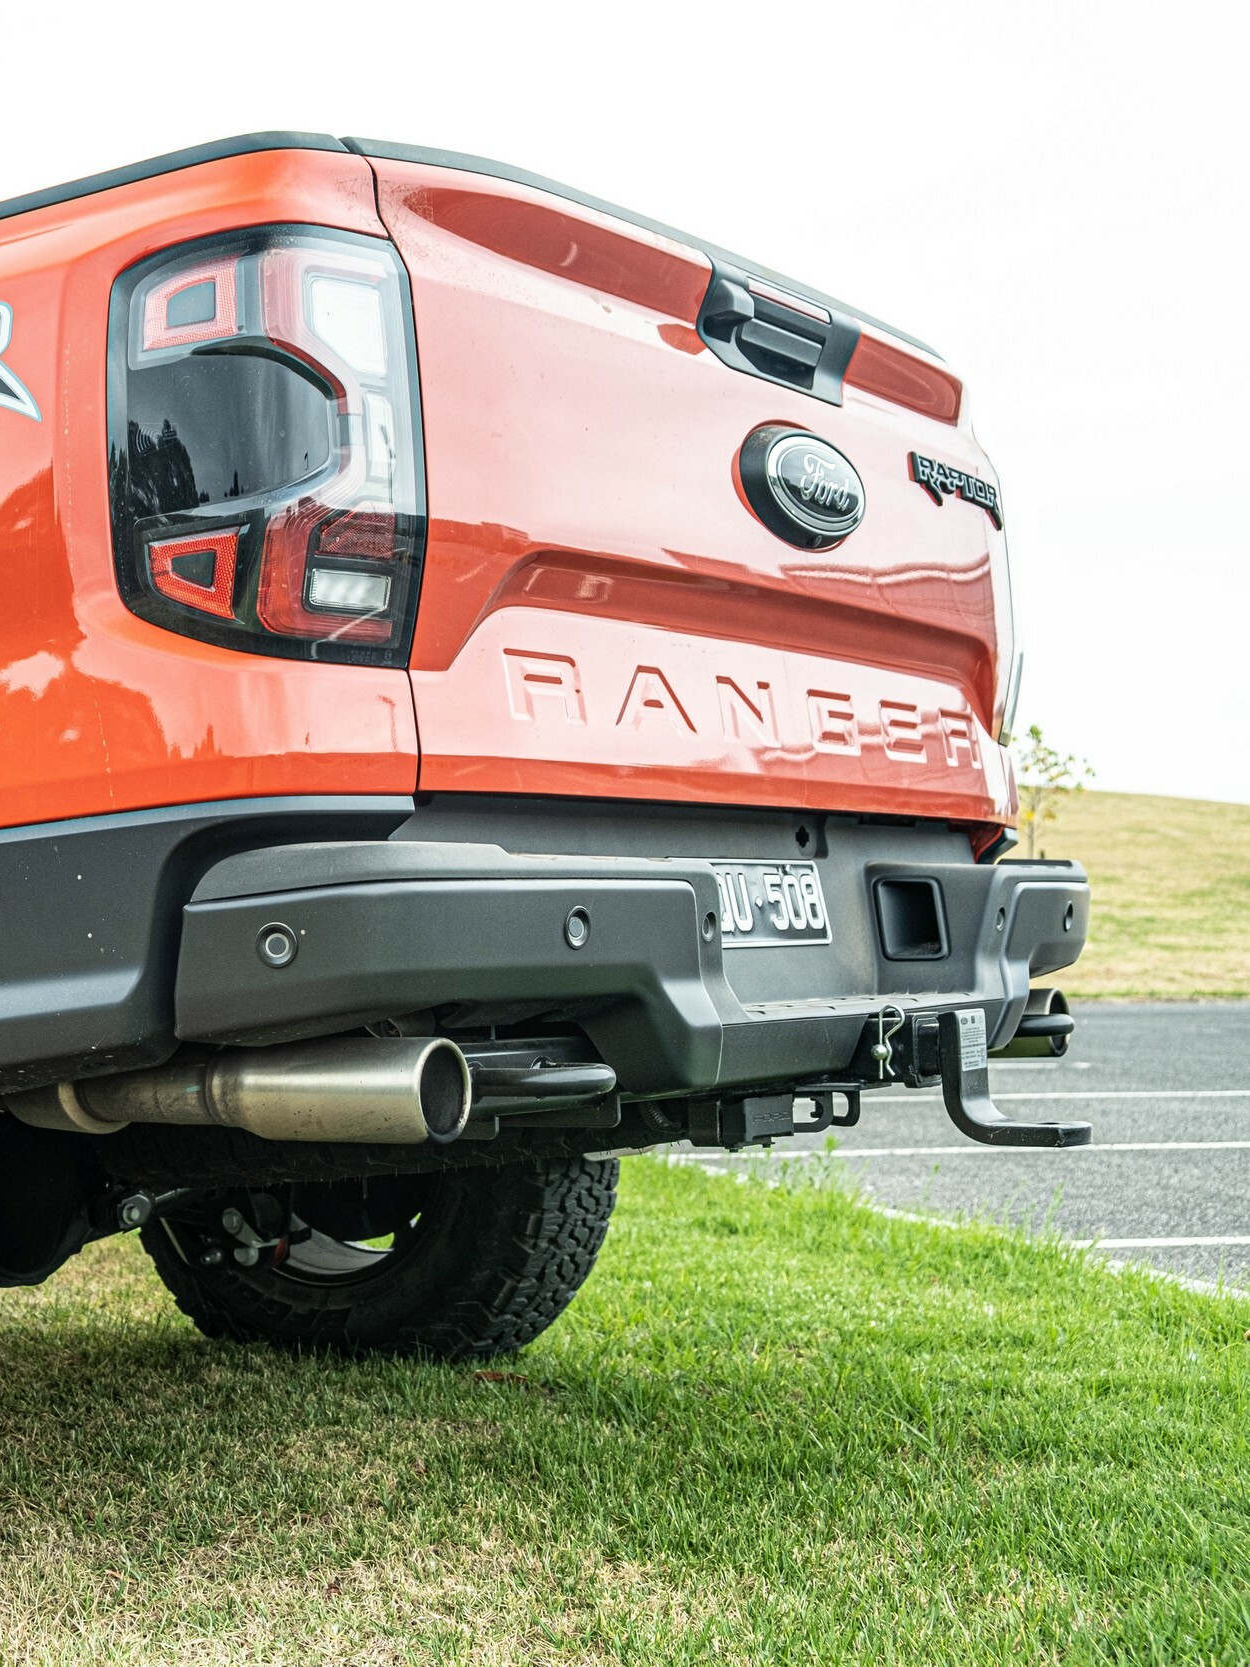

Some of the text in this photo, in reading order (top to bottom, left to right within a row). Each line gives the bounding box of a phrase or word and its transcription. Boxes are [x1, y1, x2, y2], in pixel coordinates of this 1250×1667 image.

[800, 453, 849, 512] Ford
[907, 451, 1003, 531] RAPTOR
[503, 648, 982, 770] RANGER
